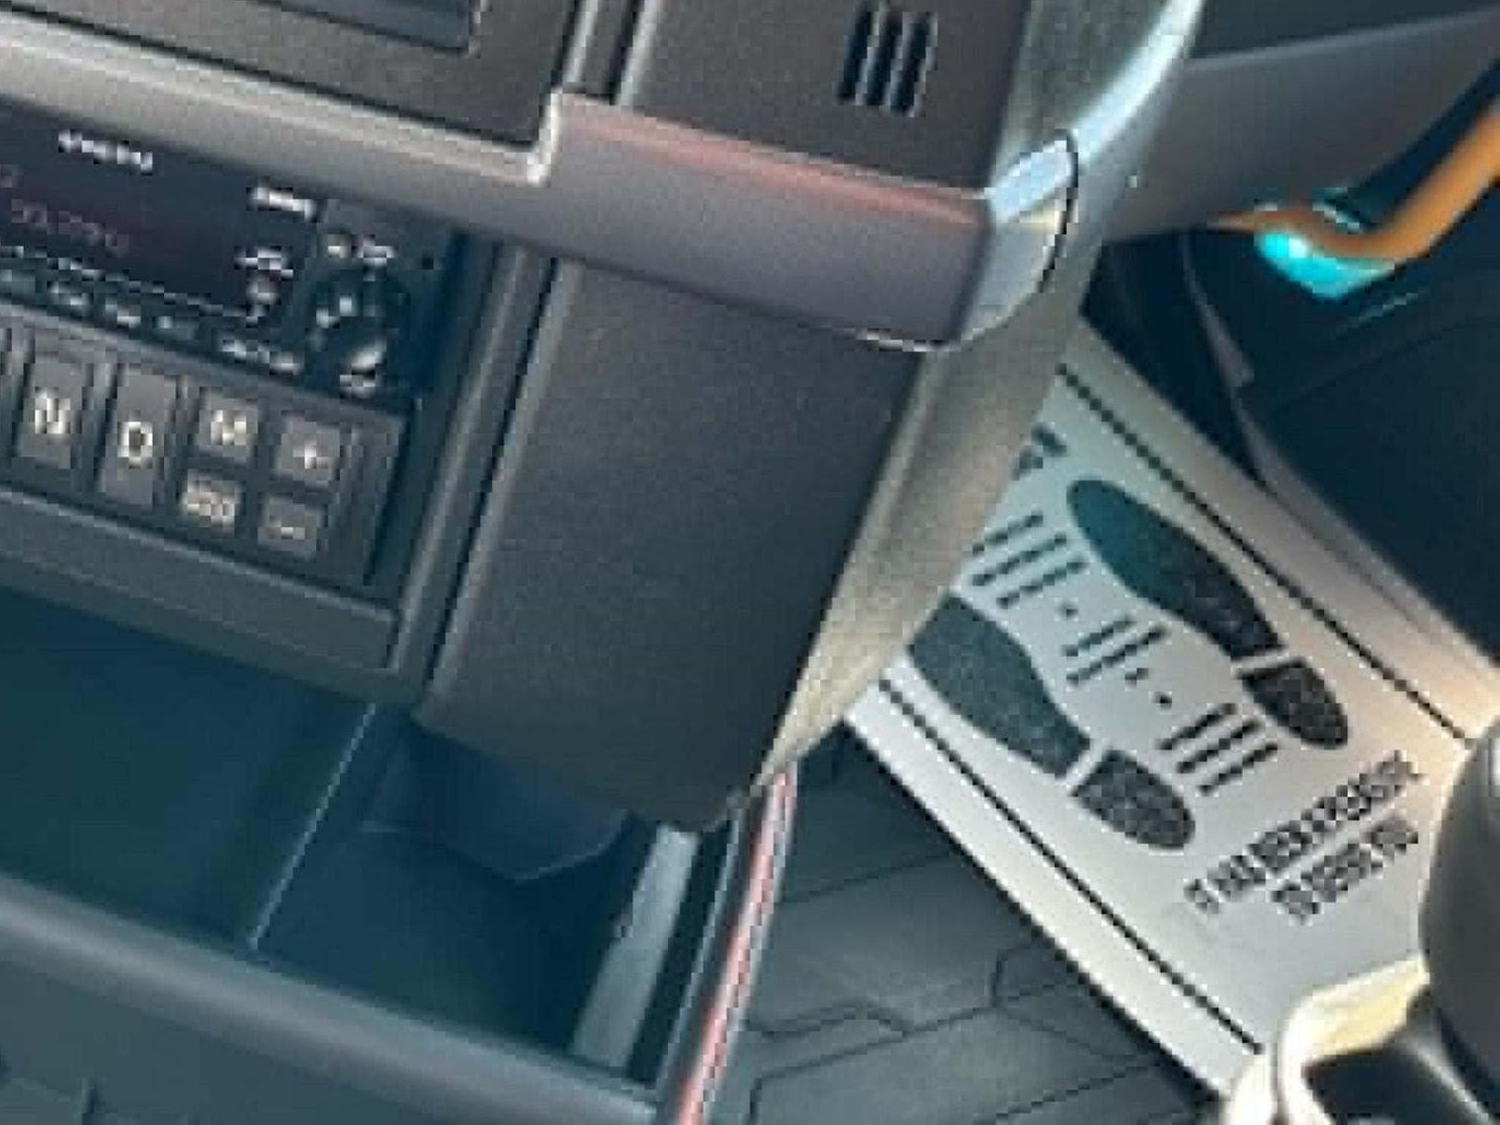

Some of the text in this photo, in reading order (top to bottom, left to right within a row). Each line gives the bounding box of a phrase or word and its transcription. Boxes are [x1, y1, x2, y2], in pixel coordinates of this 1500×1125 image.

[31, 388, 73, 439] N
[209, 406, 249, 448] M
[116, 418, 155, 468] D
[1205, 852, 1268, 903] HAS
[1246, 819, 1316, 877] BEEN
[1312, 749, 1424, 832] PLEASURE
[1270, 815, 1420, 924] TO SERVE YOU
